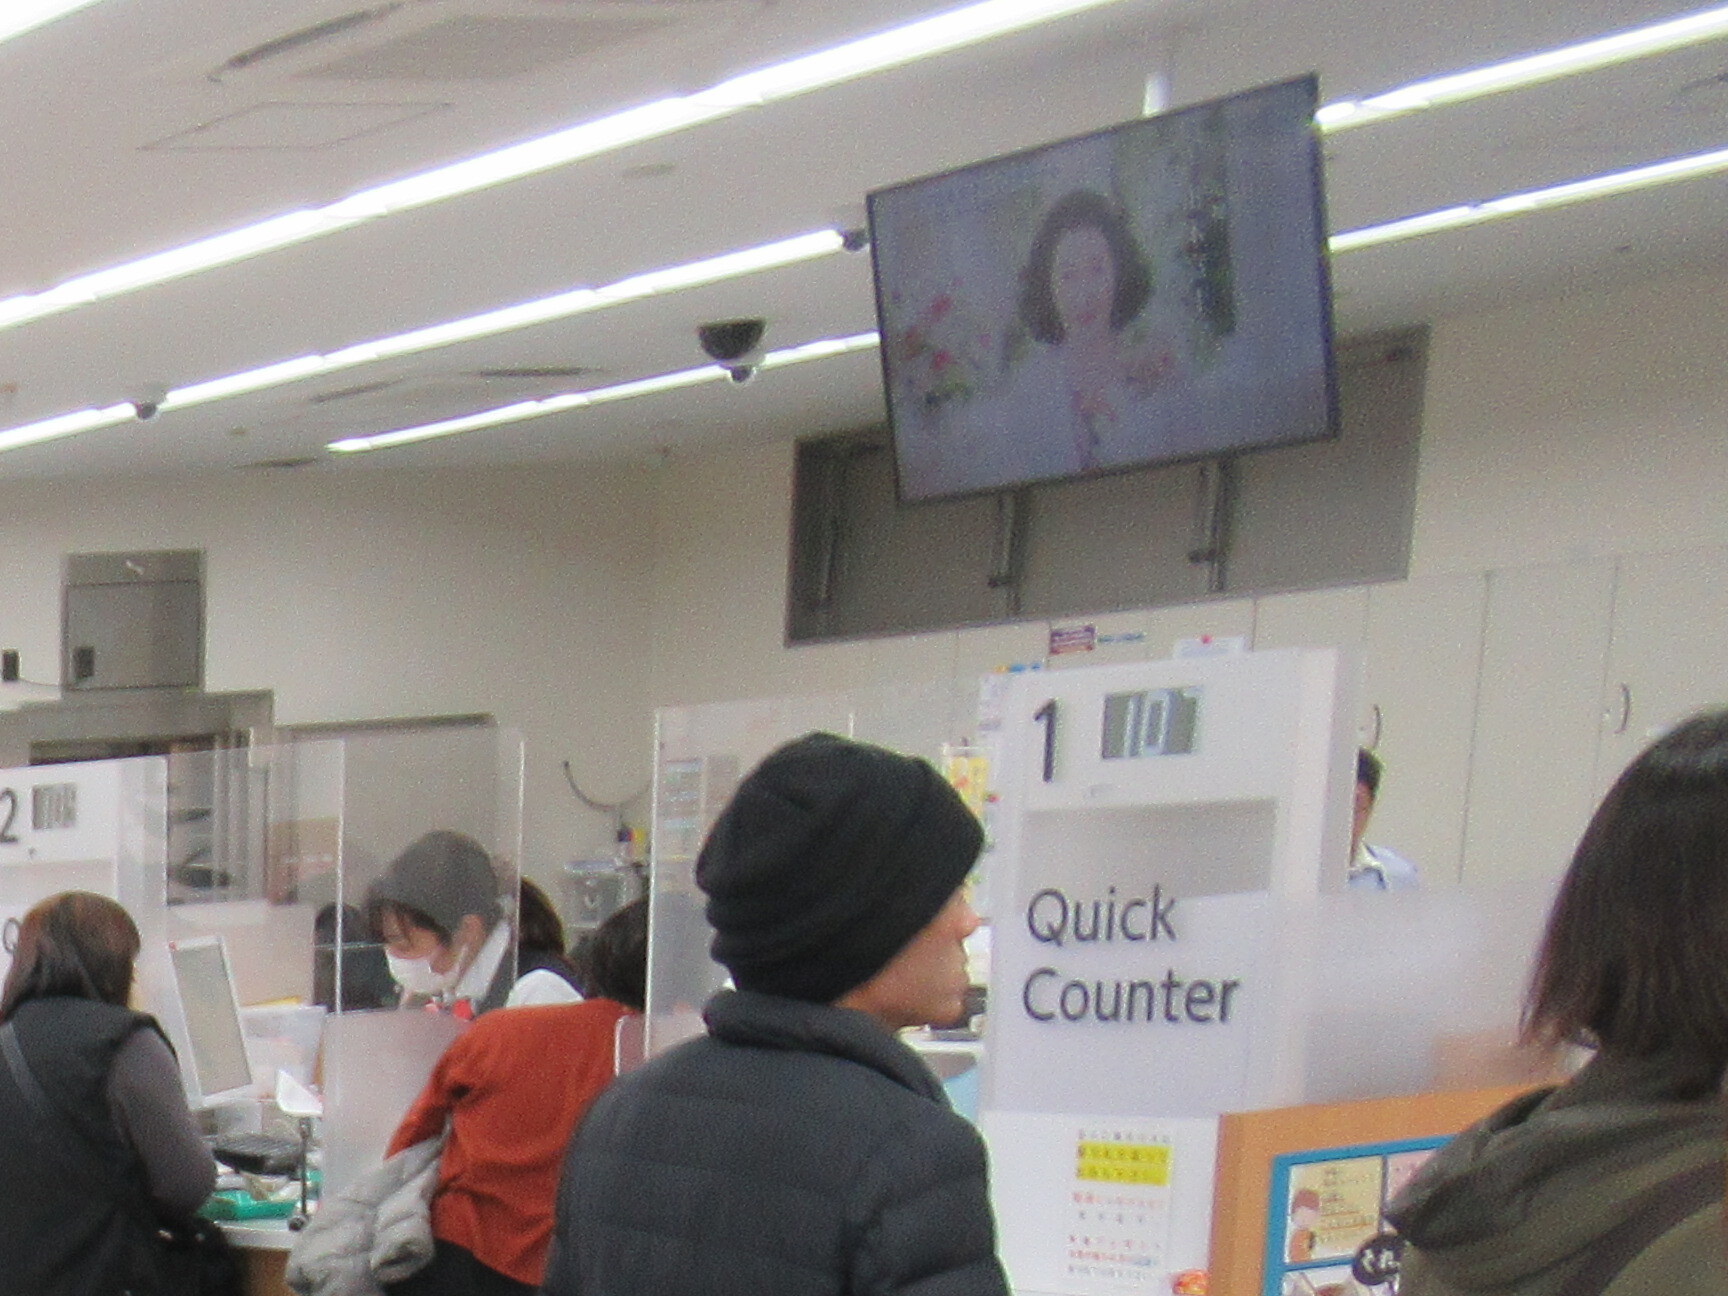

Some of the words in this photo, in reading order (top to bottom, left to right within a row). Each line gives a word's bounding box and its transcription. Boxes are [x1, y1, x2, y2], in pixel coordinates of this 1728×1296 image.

[1033, 698, 1058, 783] 1
[1027, 883, 1179, 946] Quick
[1022, 967, 1242, 1024] Counter
